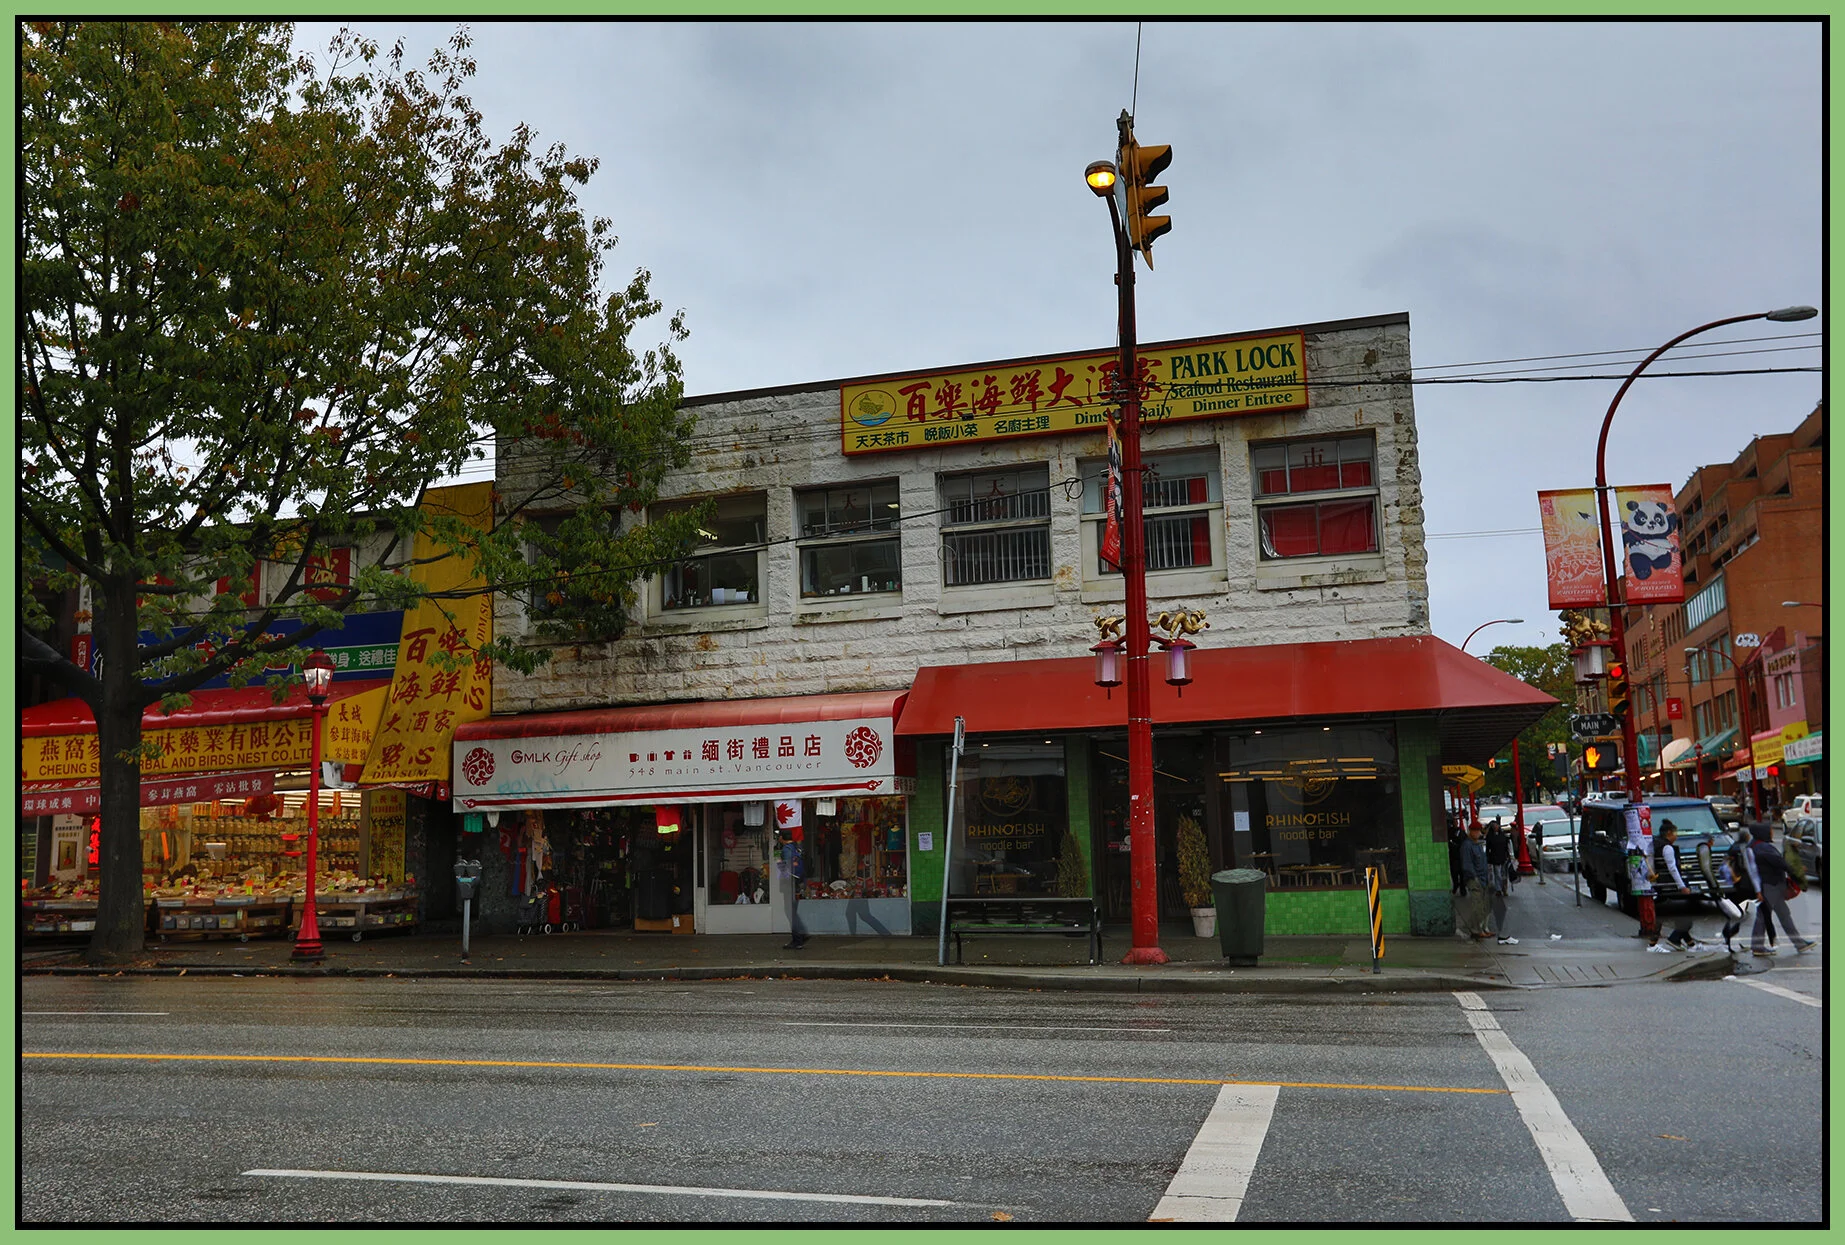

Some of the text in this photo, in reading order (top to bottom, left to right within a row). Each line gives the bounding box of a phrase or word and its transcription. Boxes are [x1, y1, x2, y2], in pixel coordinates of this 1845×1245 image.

[1170, 342, 1297, 380] PARK LOCK
[1170, 369, 1298, 399] Seafood Restaurant
[1193, 392, 1293, 412] Dinner Entree
[856, 415, 1050, 449] 天天茶市 晚飯小菜 名廚主理
[392, 669, 461, 704] 海鮮
[382, 709, 455, 734] 大酒家
[1580, 720, 1600, 730] MAIN
[511, 742, 602, 776] GMLK Gift shop
[701, 734, 822, 762] 緬街禮品店
[39, 763, 87, 776] CHEUNG
[171, 756, 196, 768] AND
[199, 754, 234, 767] BIRDS
[237, 752, 268, 764] NEST
[372, 769, 429, 779] DIM SUM
[628, 767, 655, 778] 548
[664, 765, 700, 775] main
[1265, 811, 1351, 826] RHINOFISH
[968, 823, 1045, 837] RHINOFISH
[1279, 828, 1338, 841] noodle bar
[980, 839, 1034, 851] noodle bar
